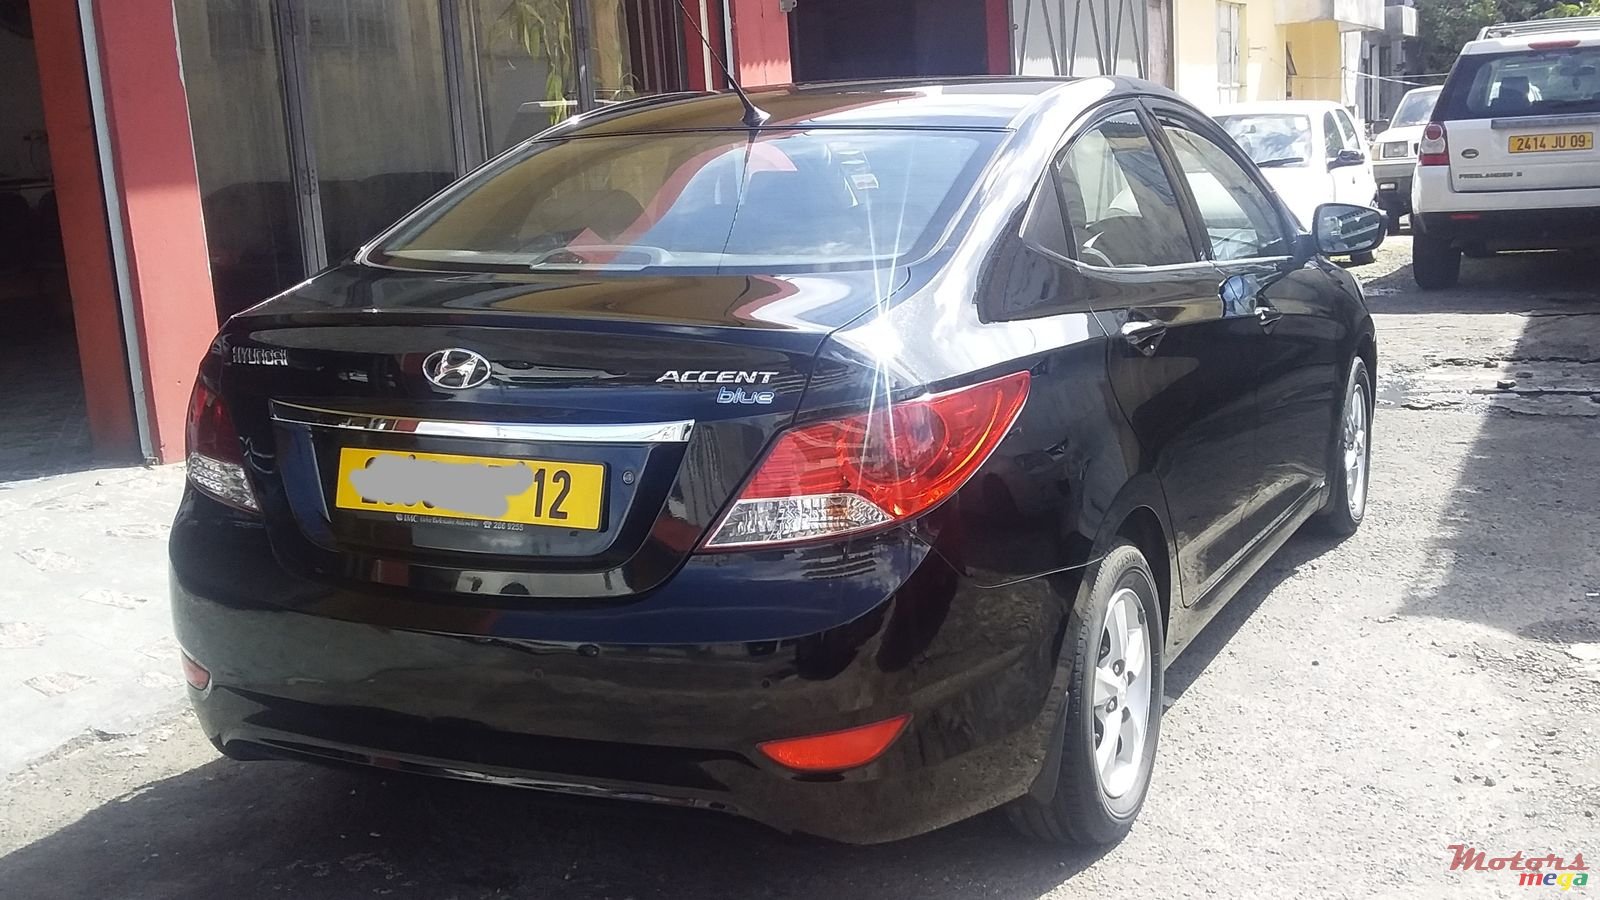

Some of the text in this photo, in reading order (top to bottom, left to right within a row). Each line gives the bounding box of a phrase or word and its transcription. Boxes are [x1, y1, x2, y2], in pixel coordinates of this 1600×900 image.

[1516, 134, 1586, 151] 2414 JU 09
[232, 346, 288, 366] HYUNDAI
[655, 370, 779, 384] ACCENT
[716, 386, 775, 404] blue
[534, 468, 571, 519] 12
